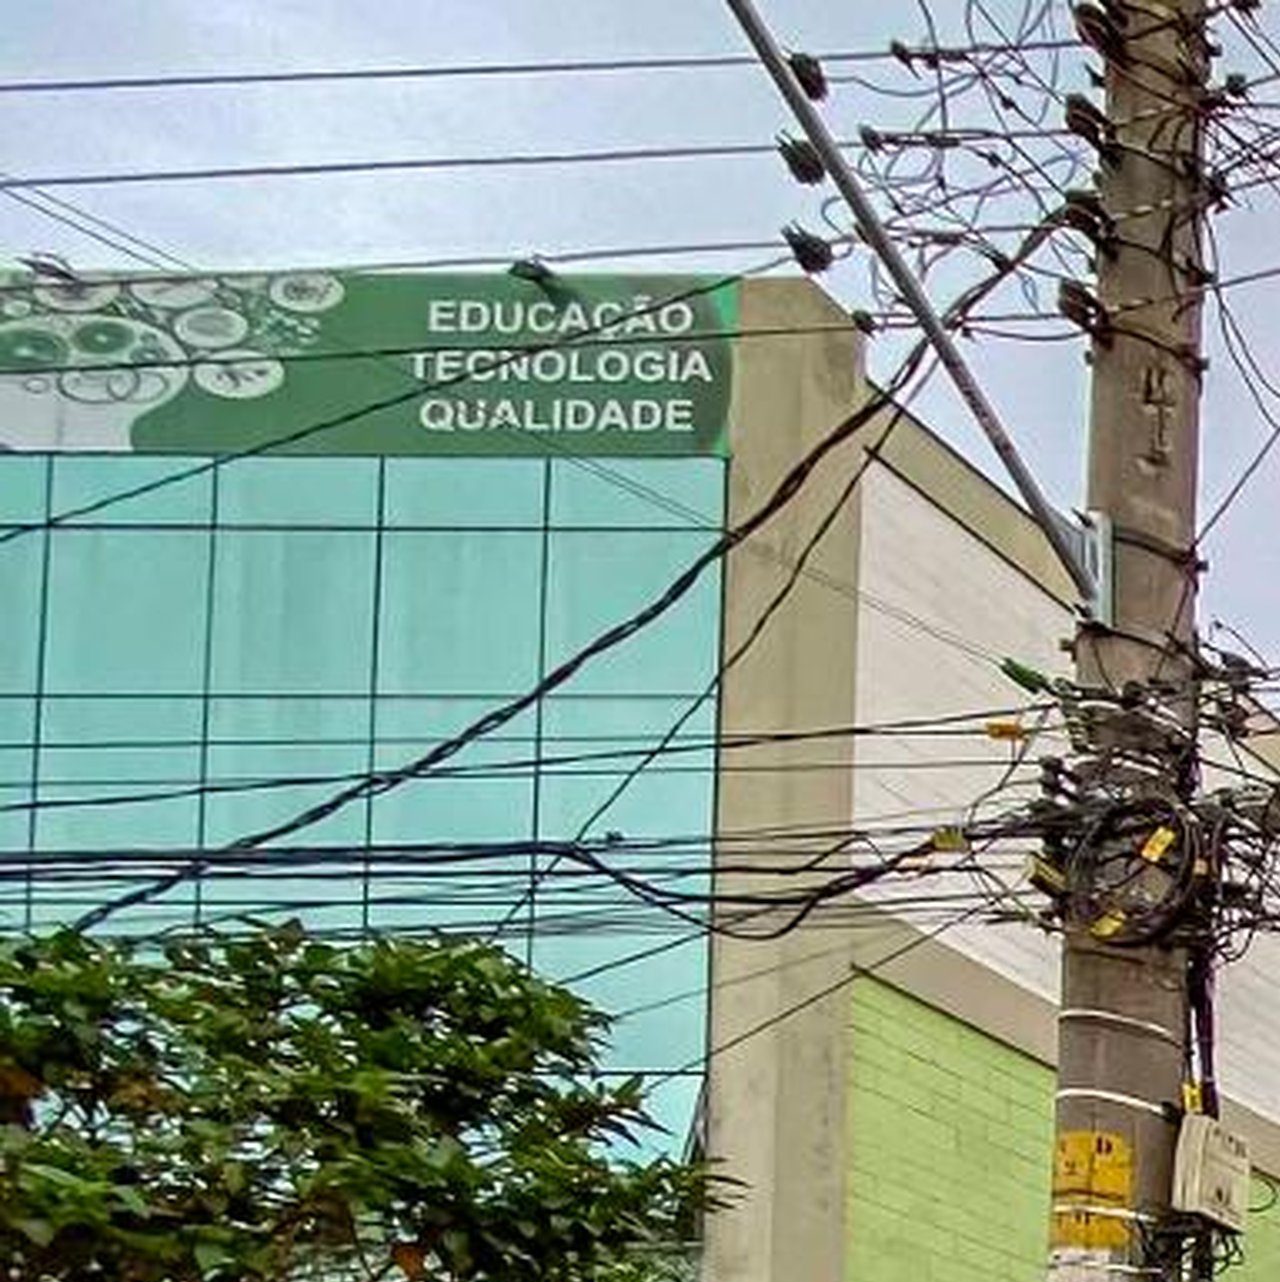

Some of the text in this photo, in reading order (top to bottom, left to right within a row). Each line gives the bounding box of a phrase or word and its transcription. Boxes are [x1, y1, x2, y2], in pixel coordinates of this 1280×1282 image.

[428, 296, 693, 339] EDUCAÇÃO
[411, 350, 712, 382] TECNOLOGIA
[420, 399, 695, 431] QUALIDADE
